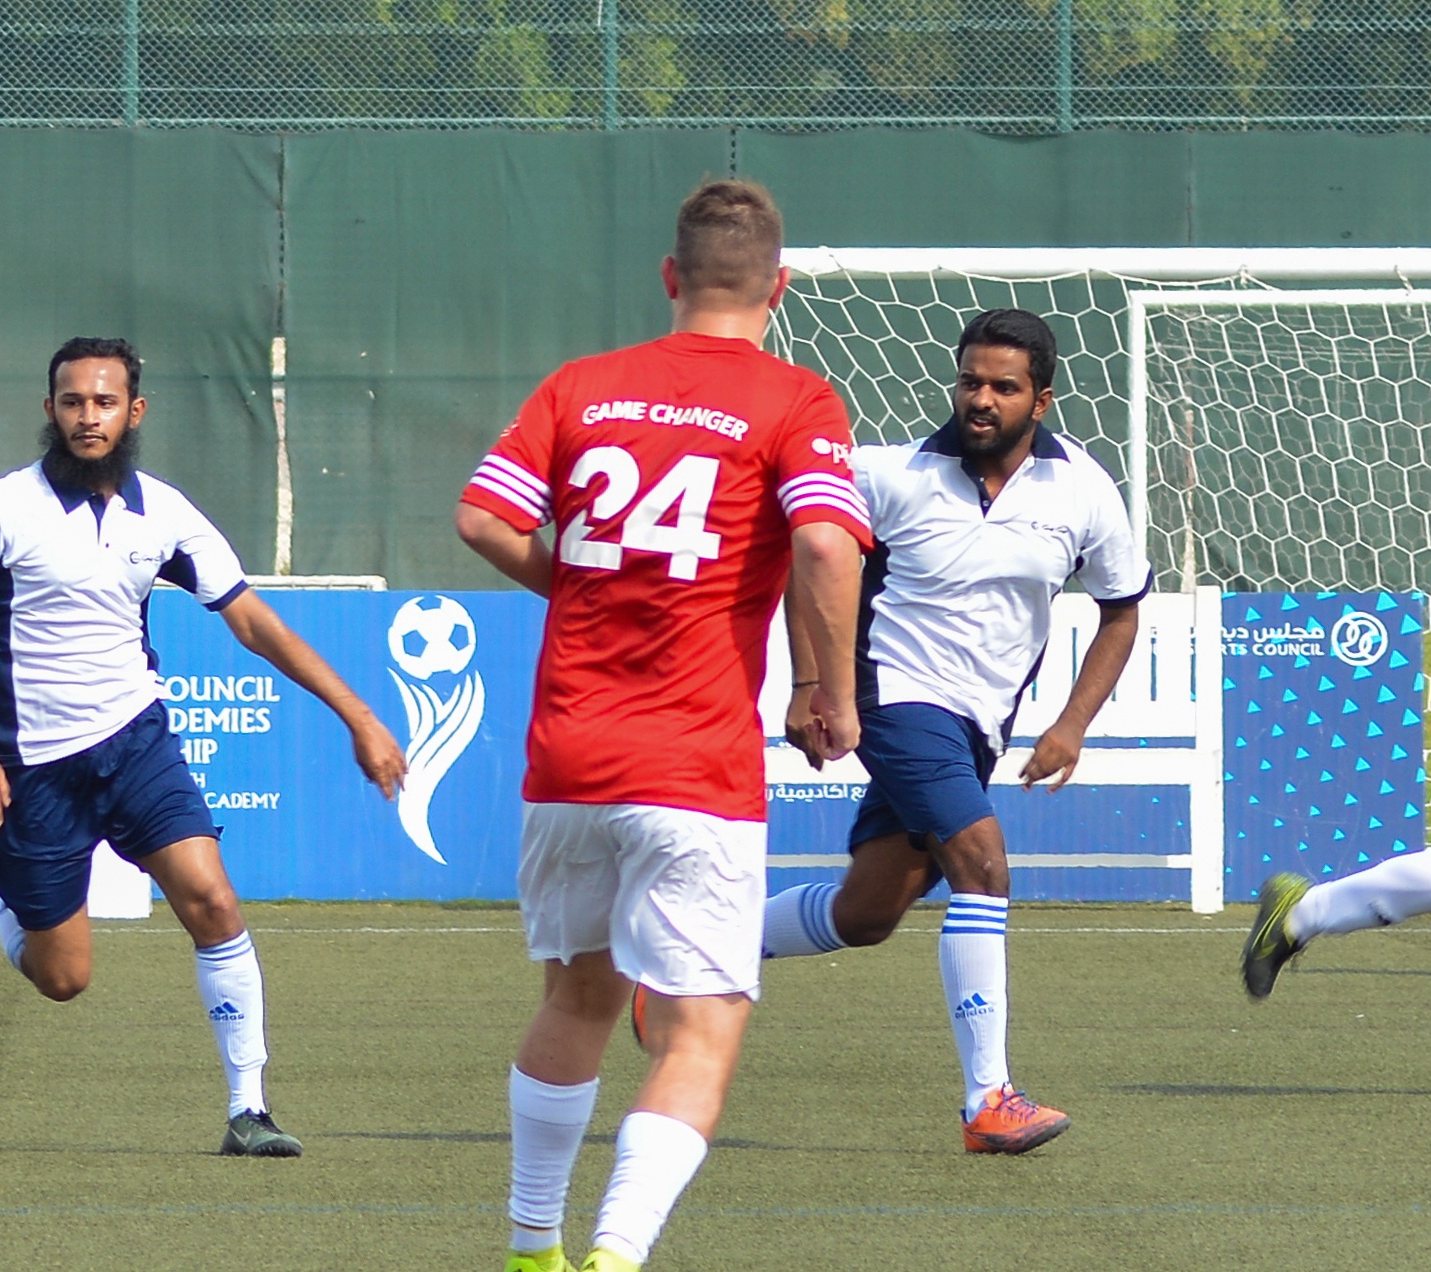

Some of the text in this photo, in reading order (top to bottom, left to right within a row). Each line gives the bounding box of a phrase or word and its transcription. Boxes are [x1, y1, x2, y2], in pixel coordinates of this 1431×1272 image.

[582, 400, 749, 441] GAME CHANGER
[560, 445, 721, 581] 24
[1253, 622, 1325, 643] مجلس
[1252, 643, 1325, 656] COUNCIL
[158, 675, 281, 702] OUNCIL
[204, 791, 281, 809] CADEMY
